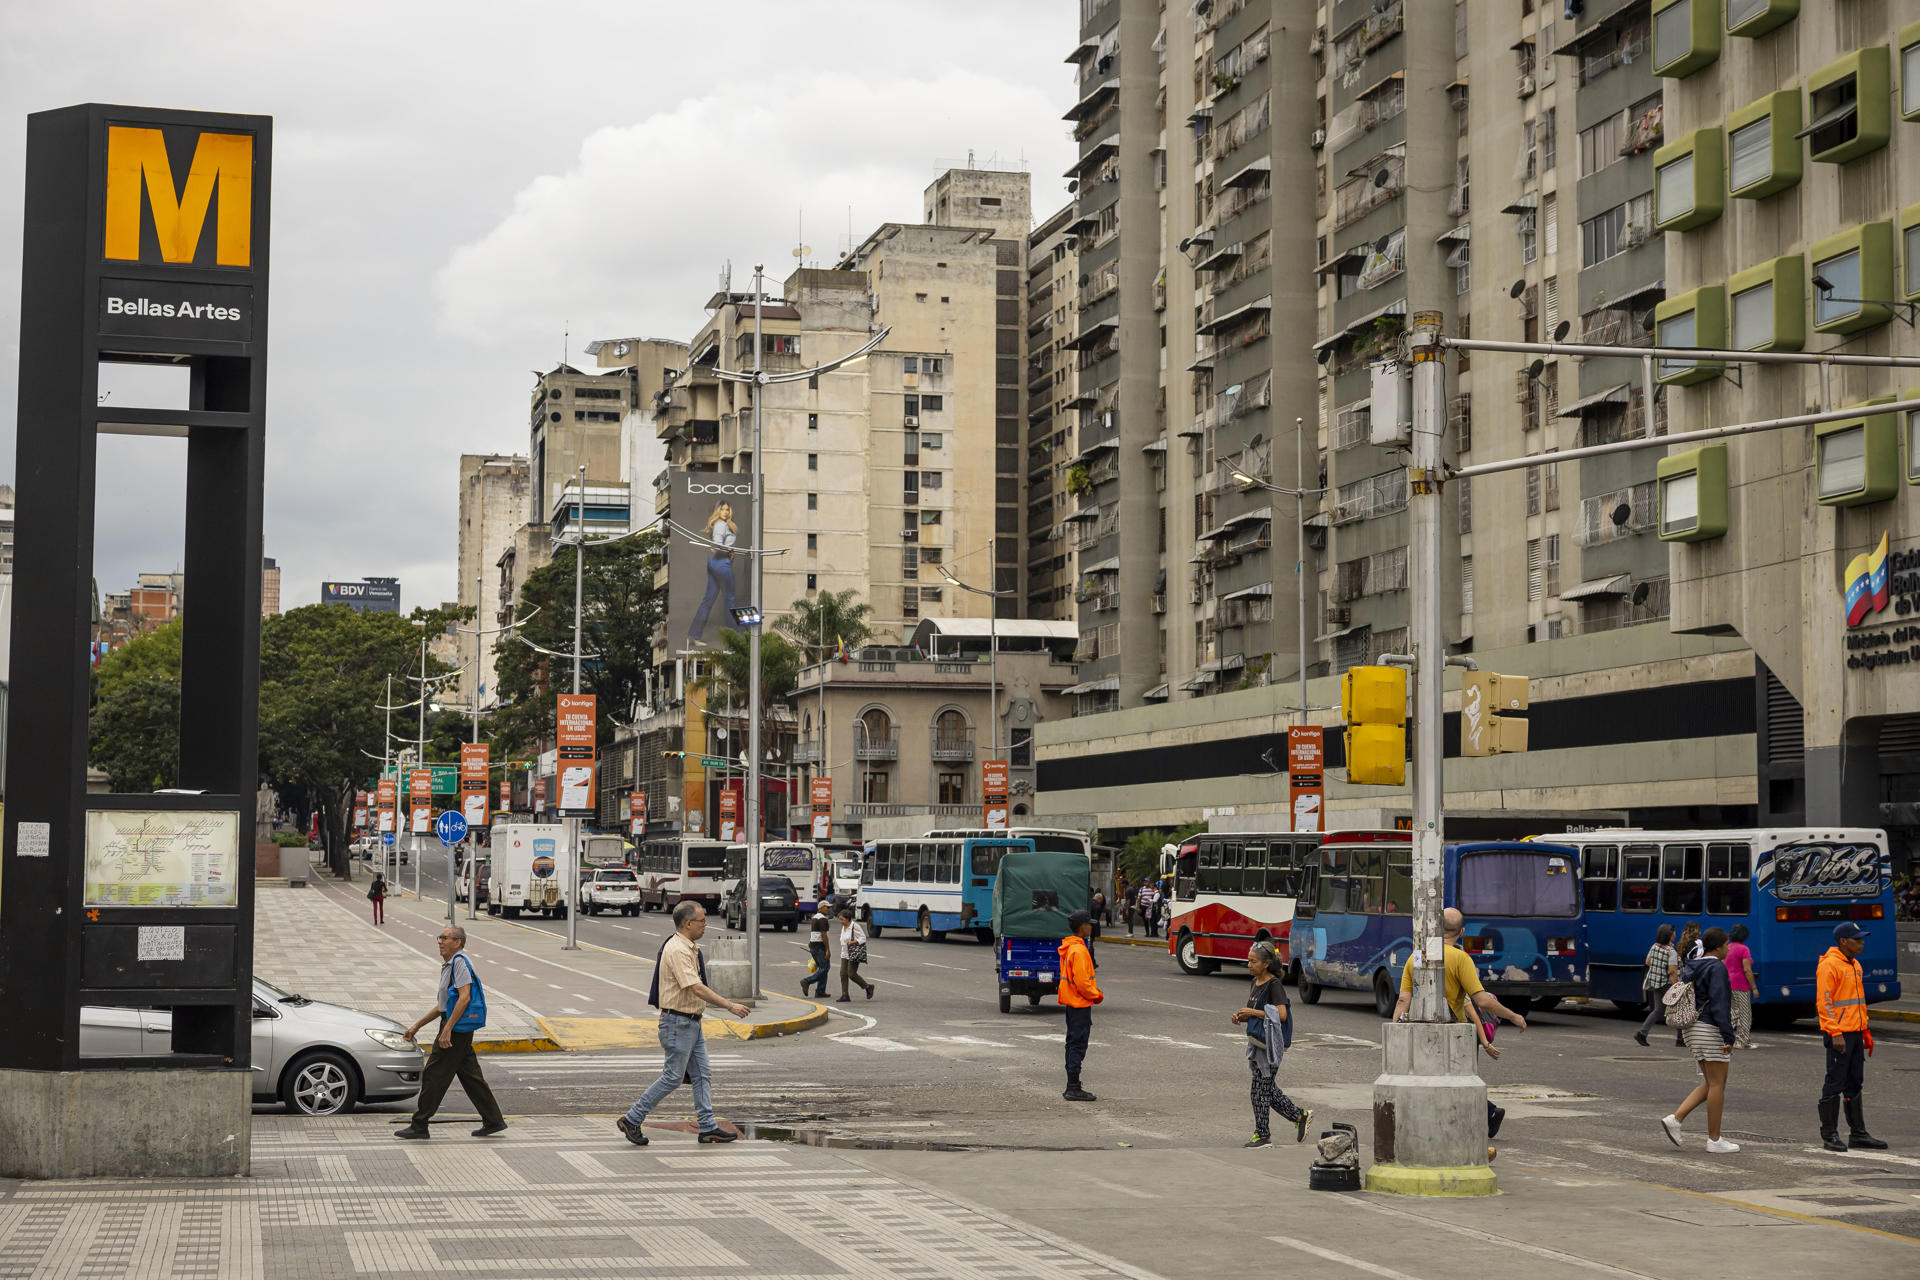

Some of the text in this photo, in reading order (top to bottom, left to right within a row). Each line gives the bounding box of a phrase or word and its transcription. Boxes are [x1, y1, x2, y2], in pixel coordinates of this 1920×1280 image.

[105, 126, 253, 267] M
[107, 297, 241, 321] Bellas Artes
[687, 477, 752, 495] bacci
[340, 585, 365, 596] BDV
[1847, 631, 1890, 650] Ministerio
[1893, 627, 1908, 643] del
[571, 700, 593, 708] kontigo
[1566, 824, 1596, 833] Bellas
